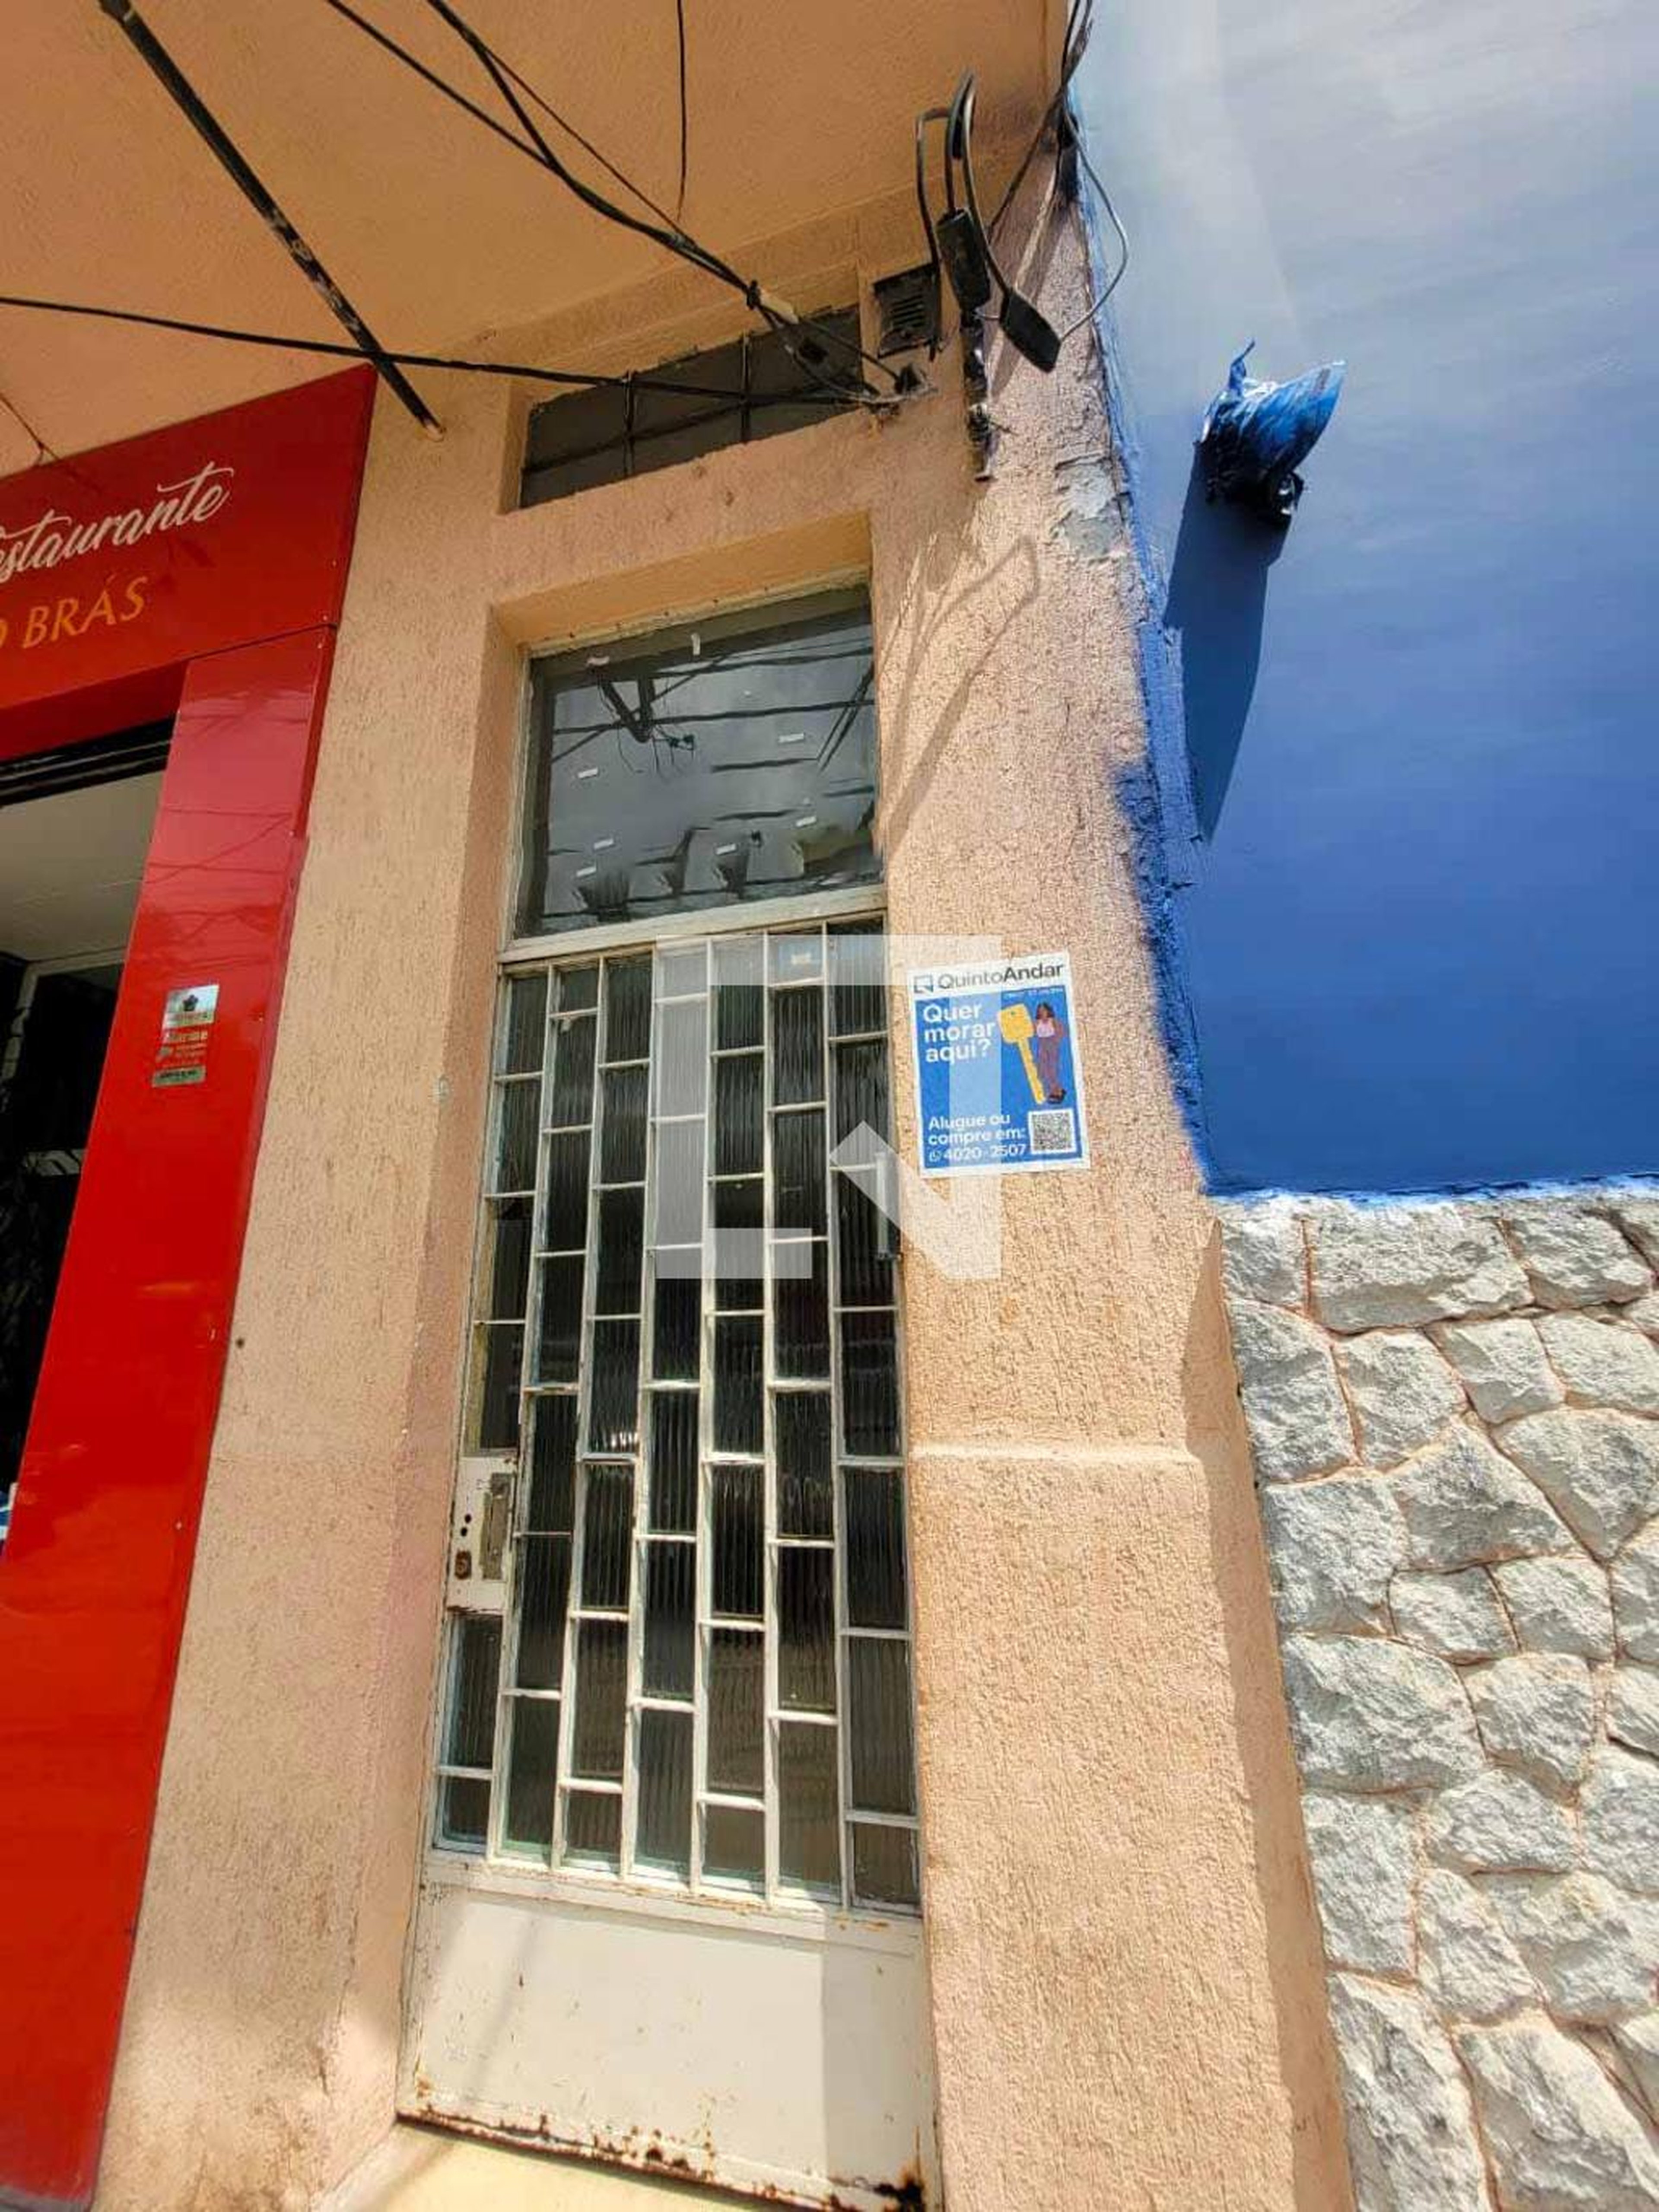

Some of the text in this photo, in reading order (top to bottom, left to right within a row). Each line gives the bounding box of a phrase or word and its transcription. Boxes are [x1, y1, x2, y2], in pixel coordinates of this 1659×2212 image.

[0, 461, 234, 583] staurante
[23, 574, 148, 648] BRÁS
[938, 963, 1064, 990] QuintoAndar
[923, 1003, 982, 1023] Quer
[924, 1021, 995, 1042] morar
[925, 1039, 992, 1063] aqui?
[929, 1114, 1011, 1131] Alugue ou
[928, 1127, 1026, 1145] compre em:
[944, 1146, 982, 1161] 4020
[990, 1143, 1027, 1158] 2507
